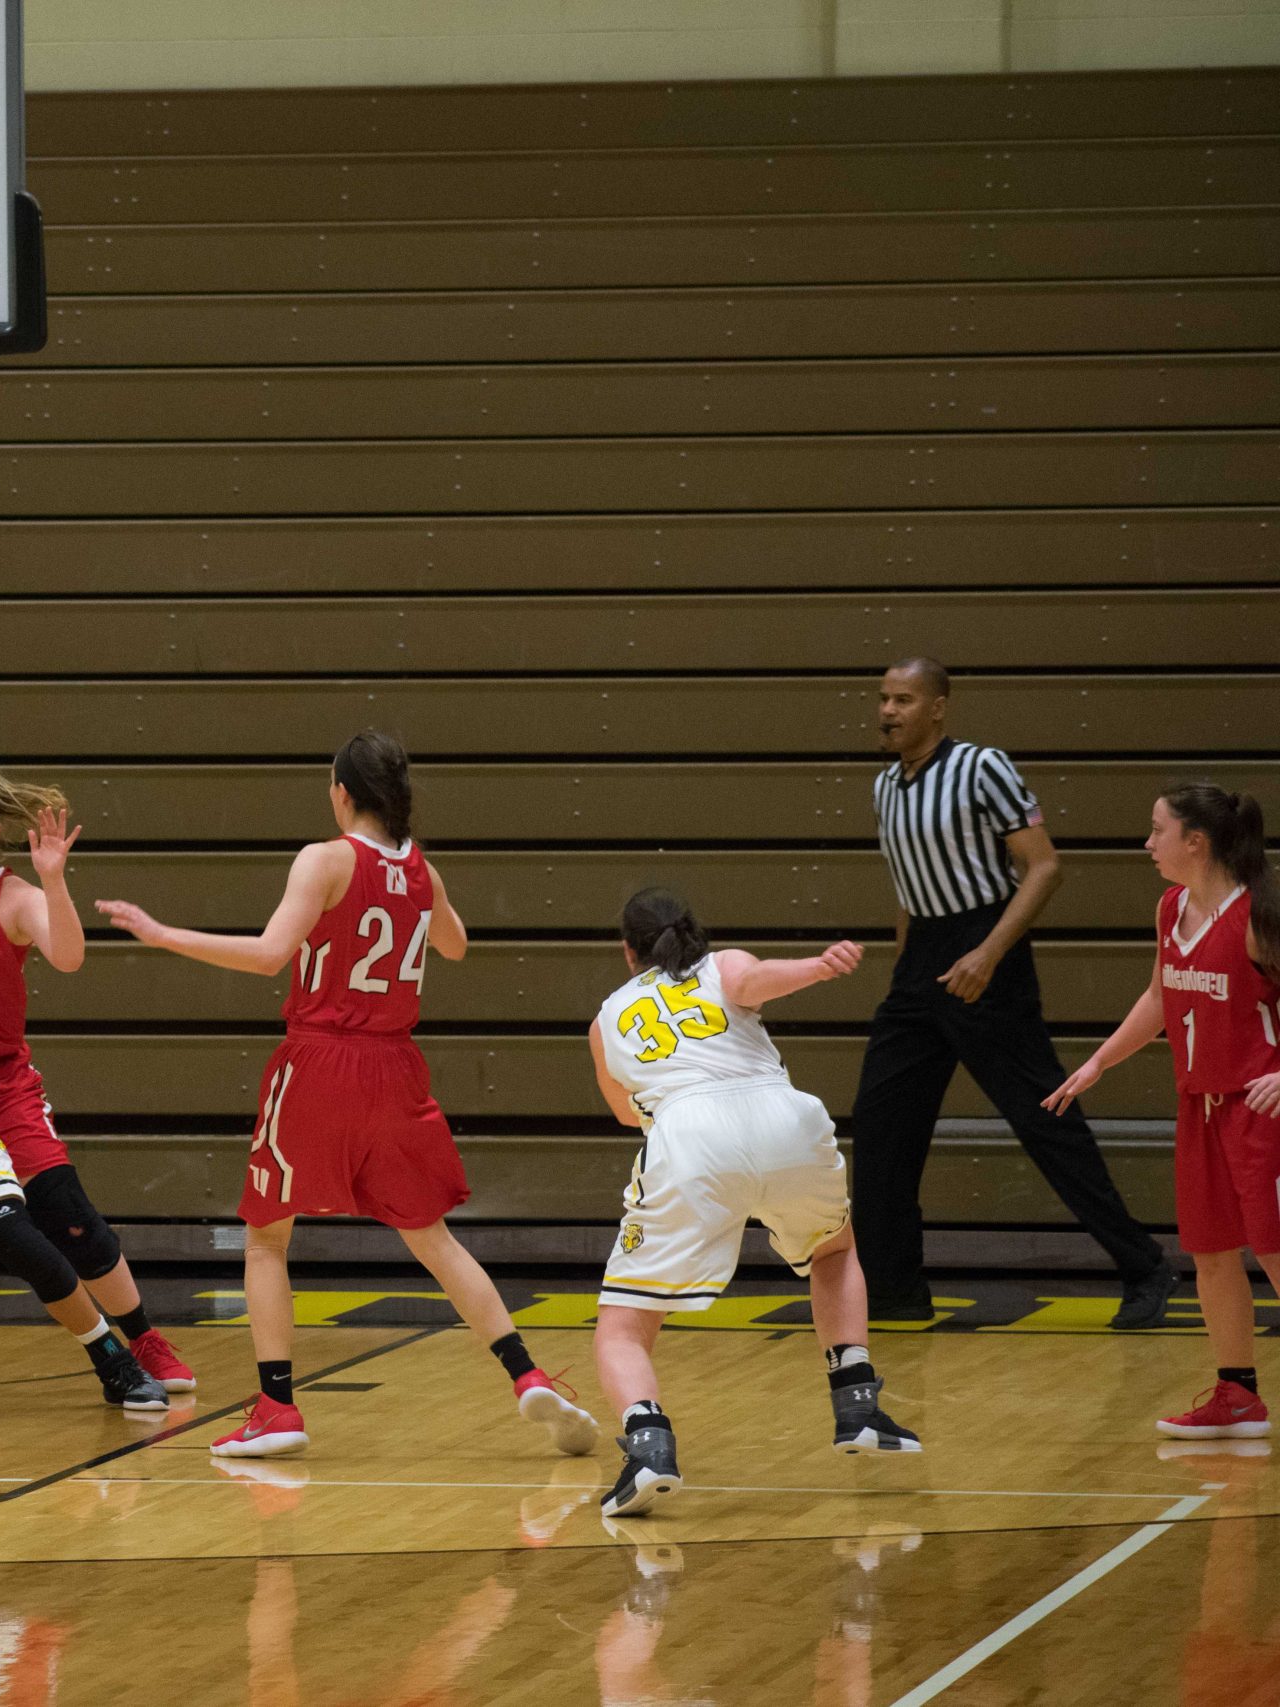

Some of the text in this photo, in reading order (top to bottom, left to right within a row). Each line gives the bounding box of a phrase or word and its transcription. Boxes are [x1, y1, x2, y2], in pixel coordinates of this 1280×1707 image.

[348, 905, 433, 997] 24
[1162, 963, 1229, 1001] ittenberg
[617, 975, 730, 1064] 35
[1181, 1007, 1196, 1073] 1
